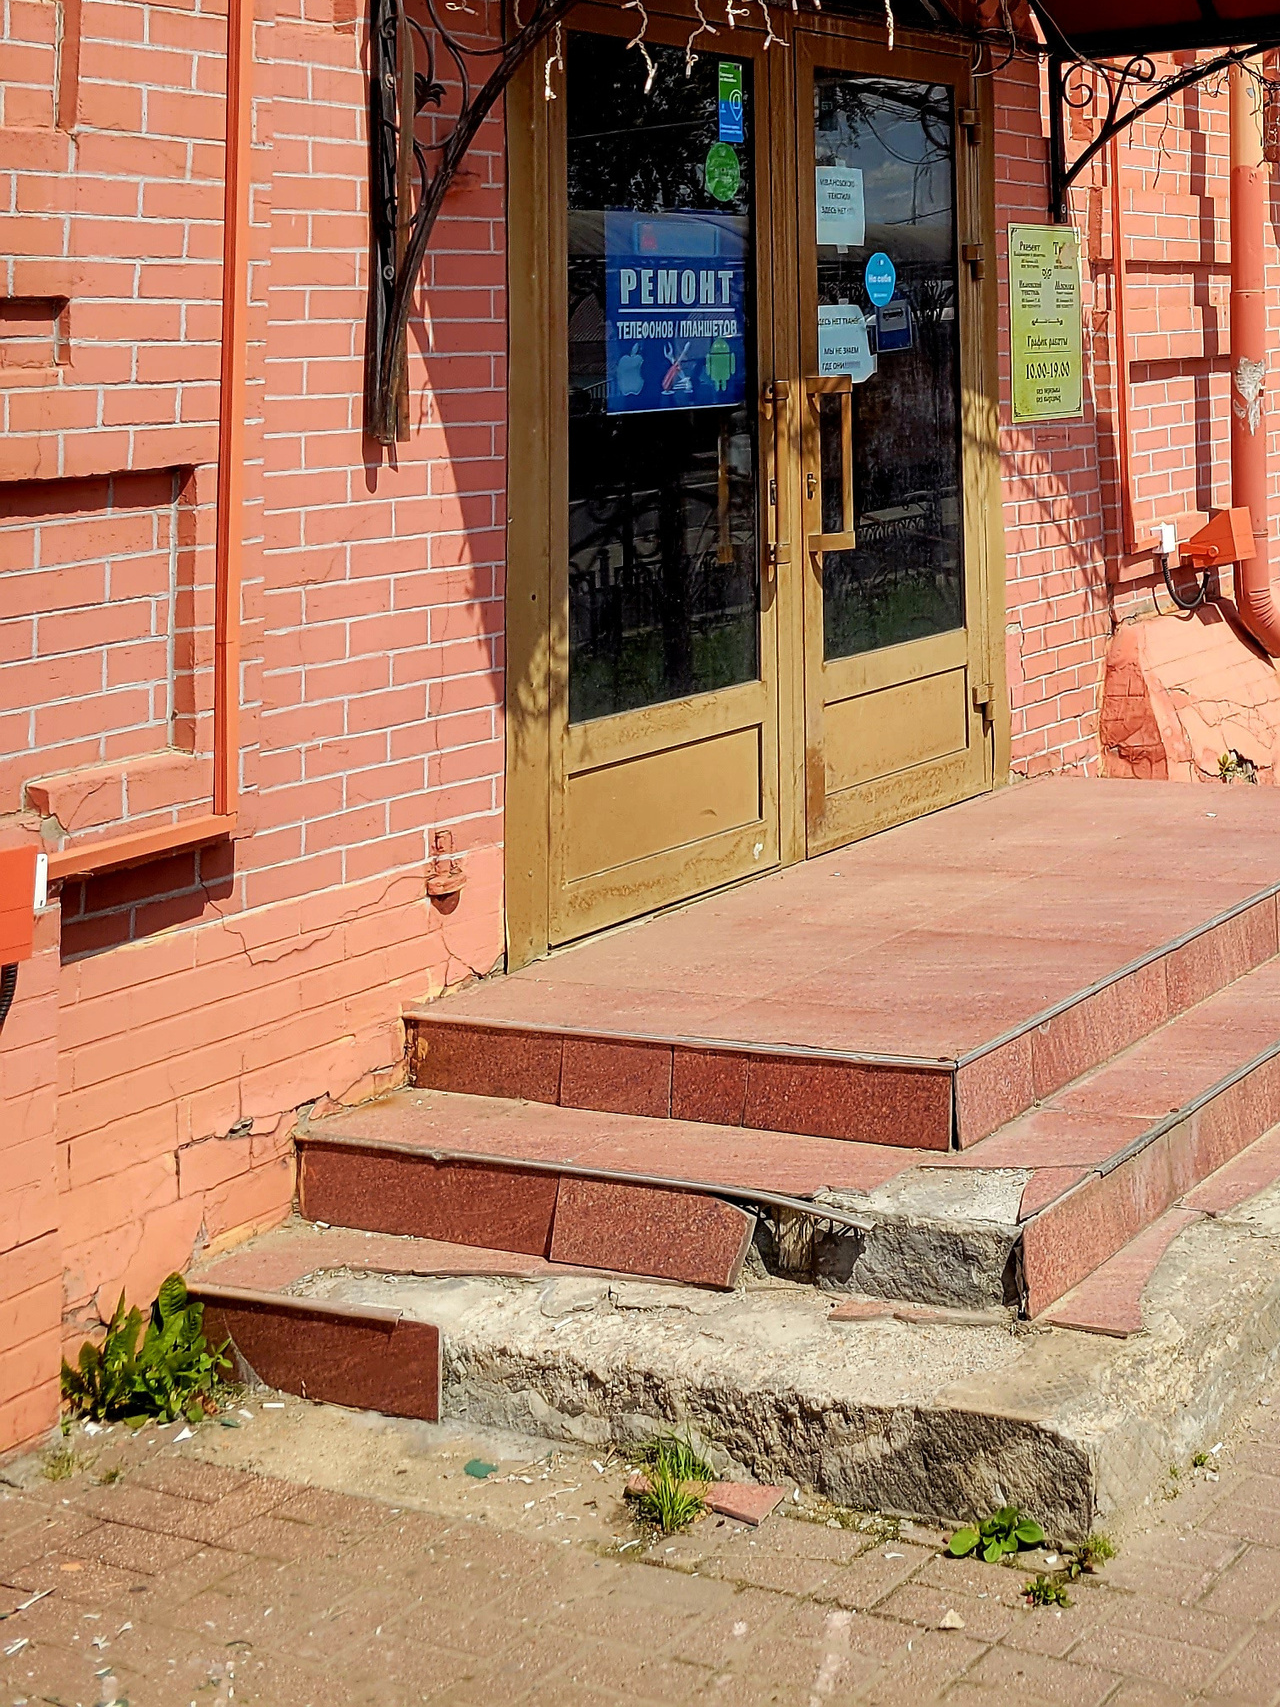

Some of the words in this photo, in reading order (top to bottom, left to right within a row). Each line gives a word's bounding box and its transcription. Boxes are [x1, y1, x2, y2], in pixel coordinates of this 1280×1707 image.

[620, 268, 734, 305] РЕМОНТ
[616, 320, 674, 340] ТЕЛЕФОНОВ
[680, 318, 738, 338] ПЛАНШЕТОВ
[824, 347, 834, 355] МЫ
[1027, 335, 1047, 350] График
[1048, 337, 1068, 349] работы
[1026, 361, 1070, 380] 10.00-19.00
